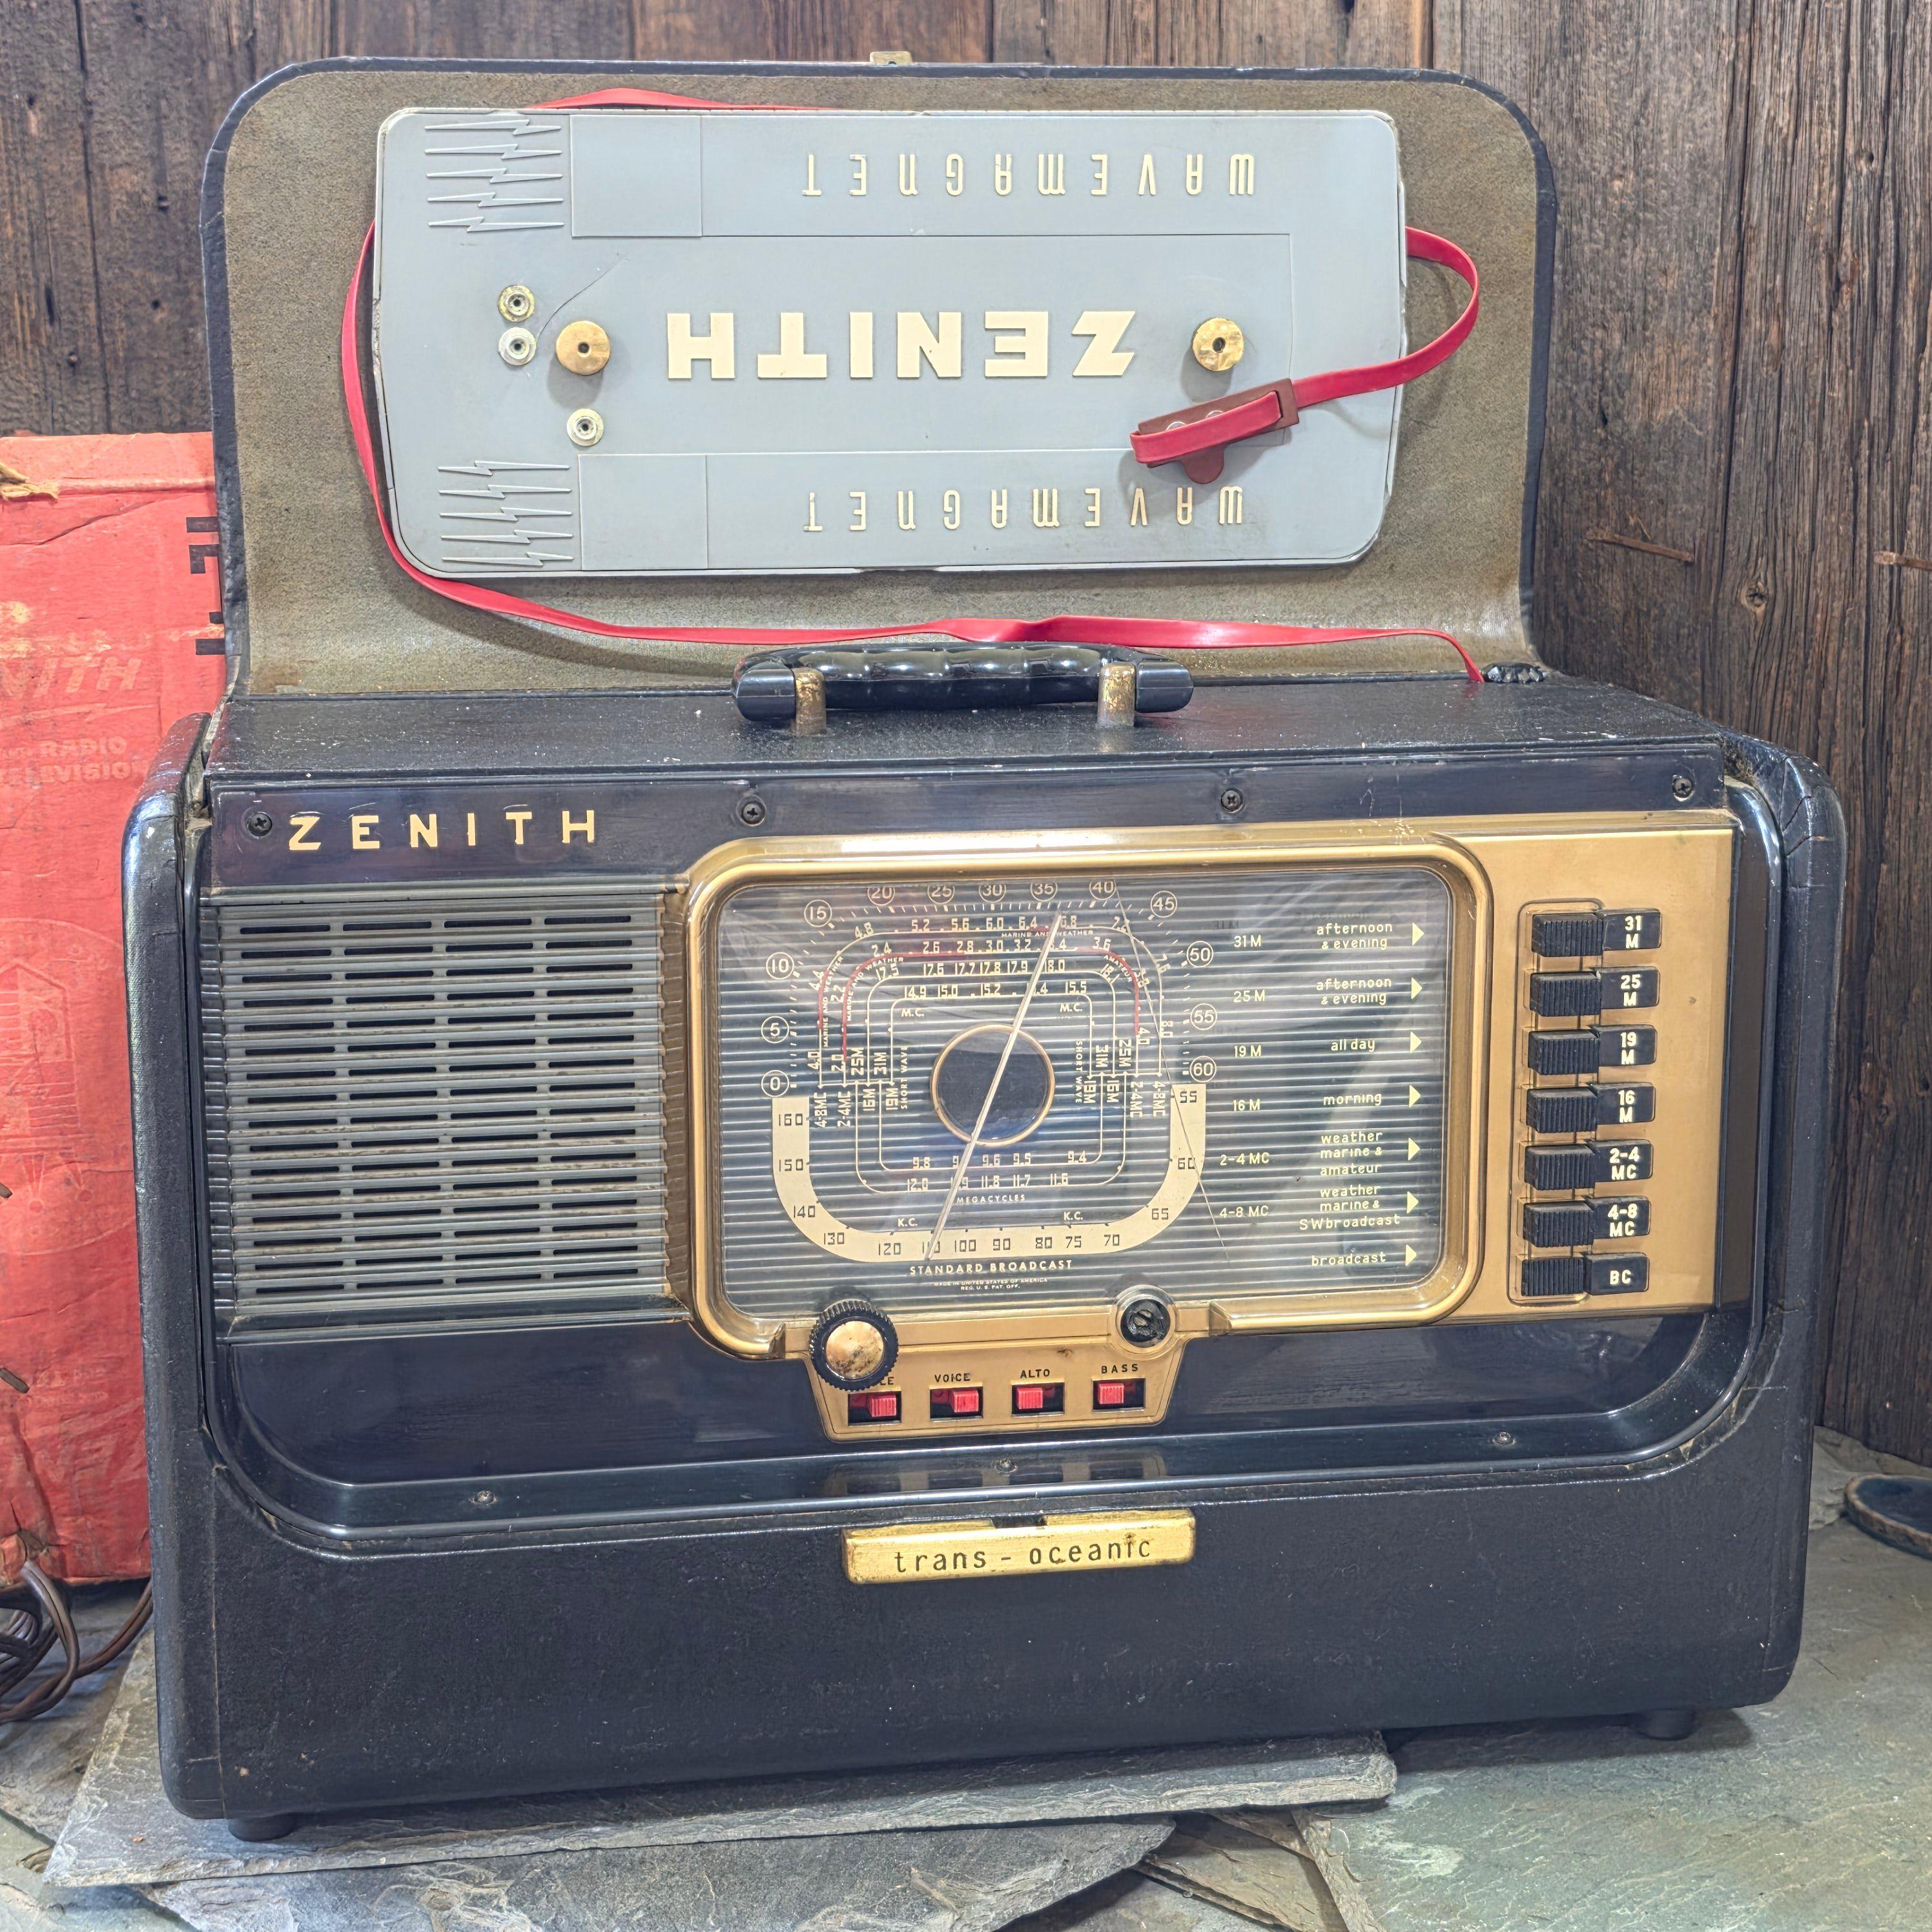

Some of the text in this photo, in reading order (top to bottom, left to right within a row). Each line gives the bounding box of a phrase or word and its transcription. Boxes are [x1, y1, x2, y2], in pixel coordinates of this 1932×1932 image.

[666, 311, 1135, 379] ZENITH
[289, 809, 595, 850] ZENITH
[1316, 922, 1393, 936] afternoon
[1625, 915, 1642, 931] 31
[871, 941, 892, 957] 2.4
[923, 941, 940, 954] 2.6
[957, 940, 974, 954] 2.8
[986, 940, 1003, 952] 3.0
[1014, 939, 1031, 952] 3.2
[1093, 937, 1111, 951] 3.6
[1321, 938, 1388, 951] & evening
[1625, 934, 1639, 949] M
[876, 963, 899, 981] 17.5
[923, 963, 944, 977] 17.6
[956, 962, 976, 976] 17.7
[980, 961, 1001, 975] 17.8
[1007, 960, 1028, 974] 17.9
[1045, 959, 1065, 972] 18.0
[1104, 954, 1133, 982] AMATEUR
[855, 922, 874, 938] 4.8
[912, 919, 930, 932] 5.2
[951, 918, 969, 931] 5.6
[986, 917, 1004, 930] 6.0
[1019, 916, 1038, 929] 6.4
[1060, 915, 1077, 928] 6.8
[1162, 1020, 1174, 1038] 8.0
[1316, 977, 1392, 991] afternoon
[1620, 974, 1641, 990] 25
[770, 881, 1214, 1091] 0 5 10 15 20 25 30 35 40 45 50 55 60
[904, 985, 927, 999] 14.9
[938, 984, 958, 998] 15.0
[981, 983, 1001, 997] 15.2
[1065, 980, 1087, 994] 15.5
[1321, 992, 1388, 1006] & evening
[1623, 991, 1638, 1007] M
[901, 1008, 925, 1017] M.C.
[1060, 1003, 1083, 1012] M.C.
[1331, 1038, 1376, 1053] all day
[1619, 1031, 1638, 1048] 19
[1095, 1045, 1109, 1067] 31M
[1118, 1039, 1132, 1067] 25M
[1621, 1049, 1636, 1065] M
[850, 1047, 865, 1076] 25M
[874, 1052, 887, 1075] 31M
[900, 1045, 909, 1109] SHORT WAVE
[1179, 1090, 1197, 1104] 55
[1323, 1093, 1382, 1106] morning
[1618, 1089, 1636, 1106] 16
[778, 1113, 803, 1126] 160
[1619, 1107, 1634, 1123] M
[1321, 1130, 1383, 1144] weather
[1067, 1151, 1087, 1163] 9.4
[1319, 1146, 1382, 1159] marine &
[1609, 1146, 1641, 1164] 2-4
[779, 1158, 803, 1172] 150
[1178, 1157, 1195, 1169] 60
[1320, 1163, 1383, 1176] amateur
[1611, 1164, 1638, 1180] MC
[907, 1178, 928, 1191] 12.0
[1013, 1174, 1031, 1187] 11.7
[956, 1194, 1025, 1204] MEGACYCLES
[1319, 1184, 1382, 1198] weather
[794, 1206, 816, 1218] 140
[1151, 1208, 1169, 1220] 65
[1319, 1200, 1381, 1213] marine &
[1607, 1202, 1638, 1220] 4-8
[898, 1218, 918, 1227] K.C.
[1064, 1211, 1083, 1220] K.C.
[1609, 1220, 1636, 1238] MC
[824, 1232, 845, 1245] 130
[878, 1234, 1120, 1255] 120 100 90 80 75 70
[1311, 1250, 1386, 1267] broadcast
[909, 1259, 1073, 1276] STANDARD BROADCAST
[1609, 1269, 1632, 1285] BC
[1020, 1368, 1051, 1380] ALTO
[1100, 1363, 1140, 1375] BASS
[934, 1372, 971, 1383] VOICE
